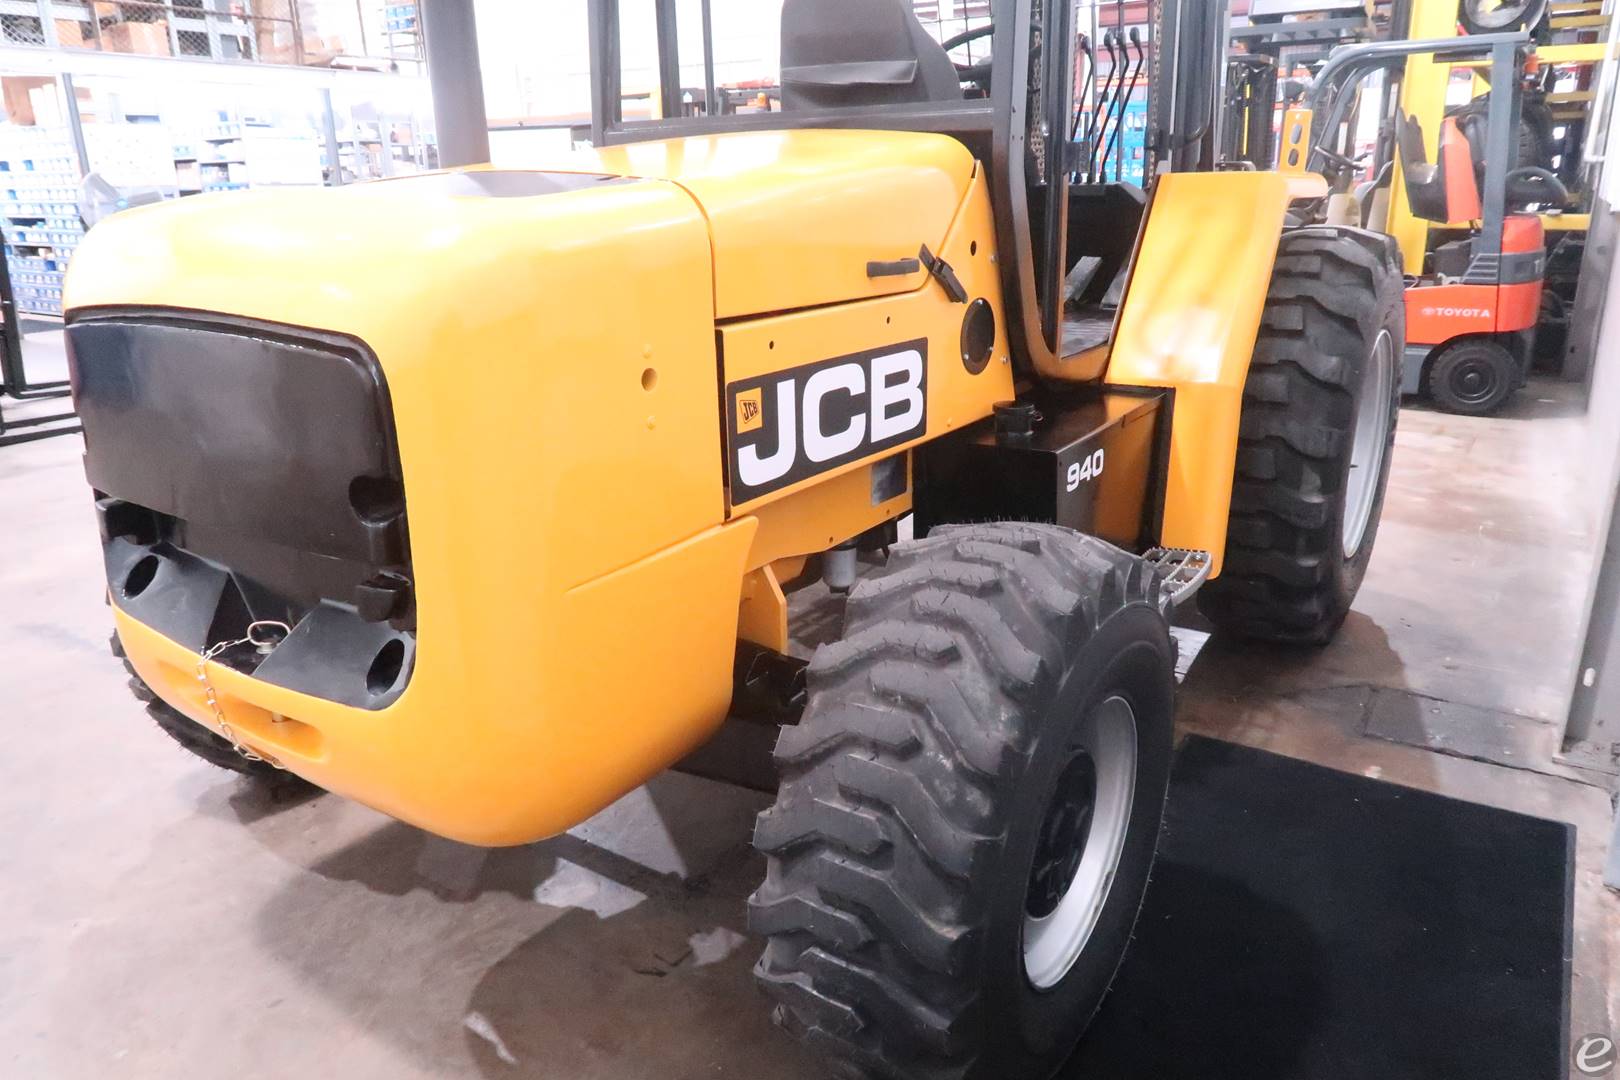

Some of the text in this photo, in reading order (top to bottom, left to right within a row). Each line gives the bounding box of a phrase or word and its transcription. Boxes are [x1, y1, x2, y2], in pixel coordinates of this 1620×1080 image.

[1435, 307, 1490, 317] TOYOTA
[738, 349, 923, 487] JCB
[742, 399, 759, 422] JCB
[1066, 448, 1105, 493] 940
